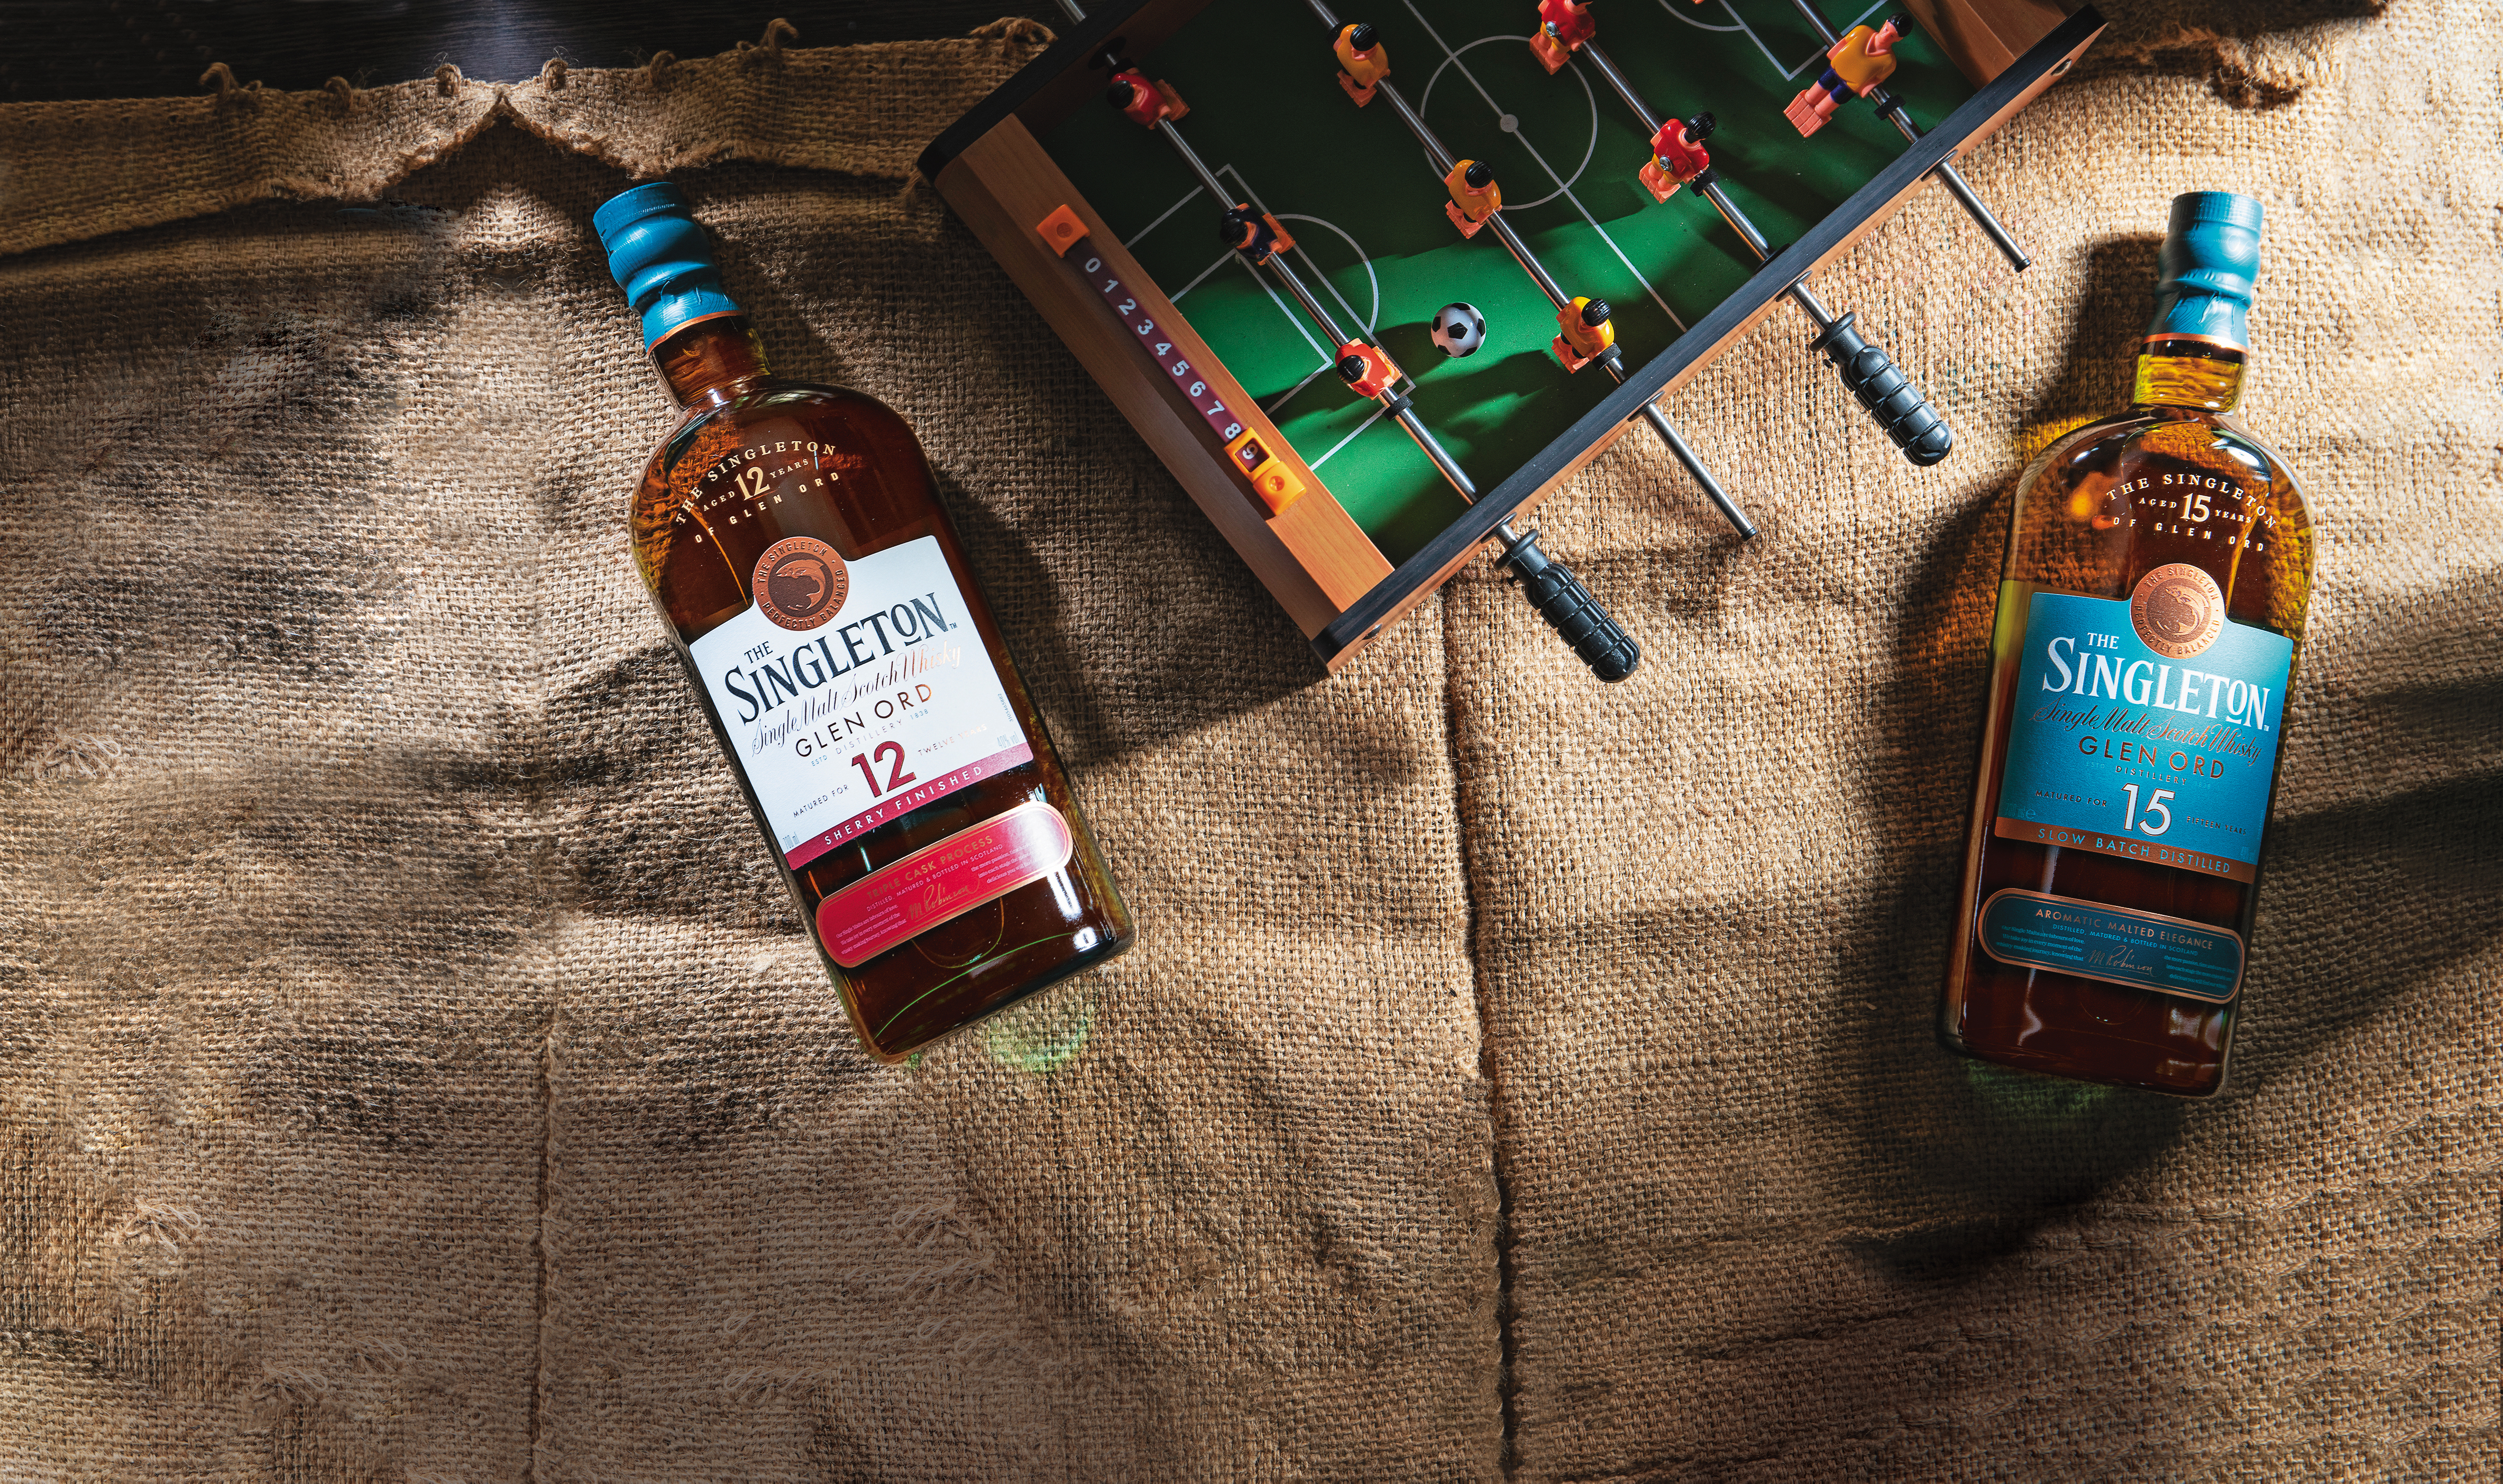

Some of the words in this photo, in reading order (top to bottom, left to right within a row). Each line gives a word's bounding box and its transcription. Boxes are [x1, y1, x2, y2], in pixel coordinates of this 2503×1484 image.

[1085, 258, 1101, 273] 0
[1104, 279, 1119, 293] 1
[1118, 298, 1136, 316] 2
[1137, 319, 1154, 335] 3
[1154, 342, 1172, 356] 4
[1172, 360, 1190, 377] 5
[1190, 381, 1206, 397] 6
[1207, 400, 1225, 416] 7
[1225, 423, 1242, 439] 8
[676, 487, 703, 524] THE
[708, 441, 836, 482] SINGLETON
[695, 528, 714, 543] OF
[730, 494, 782, 525] GLEN
[800, 472, 839, 493] ORD
[703, 490, 735, 511] AGED
[735, 466, 770, 501] 12
[769, 458, 809, 479] YEARS
[2106, 478, 2150, 501] THE
[2163, 473, 2276, 529] SINGLETON
[2139, 497, 2177, 509] AGED
[2180, 492, 2212, 522] 15
[2214, 509, 2251, 524] YEARS
[2113, 517, 2136, 527] OF
[2155, 523, 2212, 539] GLEN
[2230, 536, 2263, 552] ORD
[757, 563, 770, 583] THE
[768, 541, 828, 561] SINGLETON
[2144, 570, 2163, 588] THE
[2168, 566, 2220, 600] SINGLETON
[763, 601, 815, 629] PERFECTLY
[819, 570, 846, 621] BALANCED
[744, 640, 773, 664] THE
[2087, 632, 2120, 649] THE
[2134, 605, 2172, 654] PERFECTLY
[2177, 619, 2220, 655] BALANCED
[752, 709, 797, 757] Single
[796, 689, 839, 732] Malt
[839, 661, 900, 711] Scotch
[895, 640, 961, 683] Whisky
[795, 712, 865, 757] GLEN
[874, 684, 932, 719] ORD
[811, 755, 828, 767] ESTD
[836, 719, 902, 754] DISTILLERY
[910, 709, 929, 720] 1838
[997, 734, 1011, 749] 40%
[1010, 731, 1020, 746] vol
[2029, 694, 2101, 731] Single
[2101, 706, 2151, 736] Malt
[2145, 715, 2210, 749] Scotch
[2208, 723, 2262, 767] Whisky
[793, 794, 829, 818] MATURED
[831, 784, 849, 798] FOR
[851, 740, 916, 799] 12
[918, 736, 955, 756] TWELVE
[958, 723, 987, 739] YEARS
[2079, 736, 2157, 767] GLEN
[2169, 752, 2224, 779] ORD
[2115, 765, 2188, 786] DISTILLERY
[824, 808, 884, 845] SHERRY
[896, 765, 983, 811] FINISHED
[2036, 790, 2083, 804] MATURED
[2087, 796, 2107, 808] FOR
[2121, 783, 2176, 837] 15
[2186, 815, 2222, 830] FIFTEEN
[2224, 823, 2247, 836] YEARS
[867, 878, 901, 900] TRIPLE
[905, 860, 936, 881] CASK
[940, 835, 993, 865] PROCESS
[2038, 828, 2085, 845] SLOW
[2096, 837, 2150, 857] BATCH
[2160, 850, 2230, 873] DISTILLED
[867, 895, 895, 911] DISTILLED,
[896, 880, 924, 896] MATURED
[932, 864, 959, 880] BOTTLED
[970, 844, 1003, 862] SCOTLAND
[986, 872, 1007, 883] delicious
[2036, 909, 2101, 928] AROMATIC
[2107, 921, 2155, 938] MALTED
[2160, 931, 2213, 950] ELEGANCE
[2053, 924, 2086, 935] DISTILLED,
[2090, 931, 2121, 941] MATURED
[2131, 938, 2157, 948] BOTTLED
[2169, 945, 2198, 956] SCOTLAND
[2052, 951, 2073, 960] knowing
